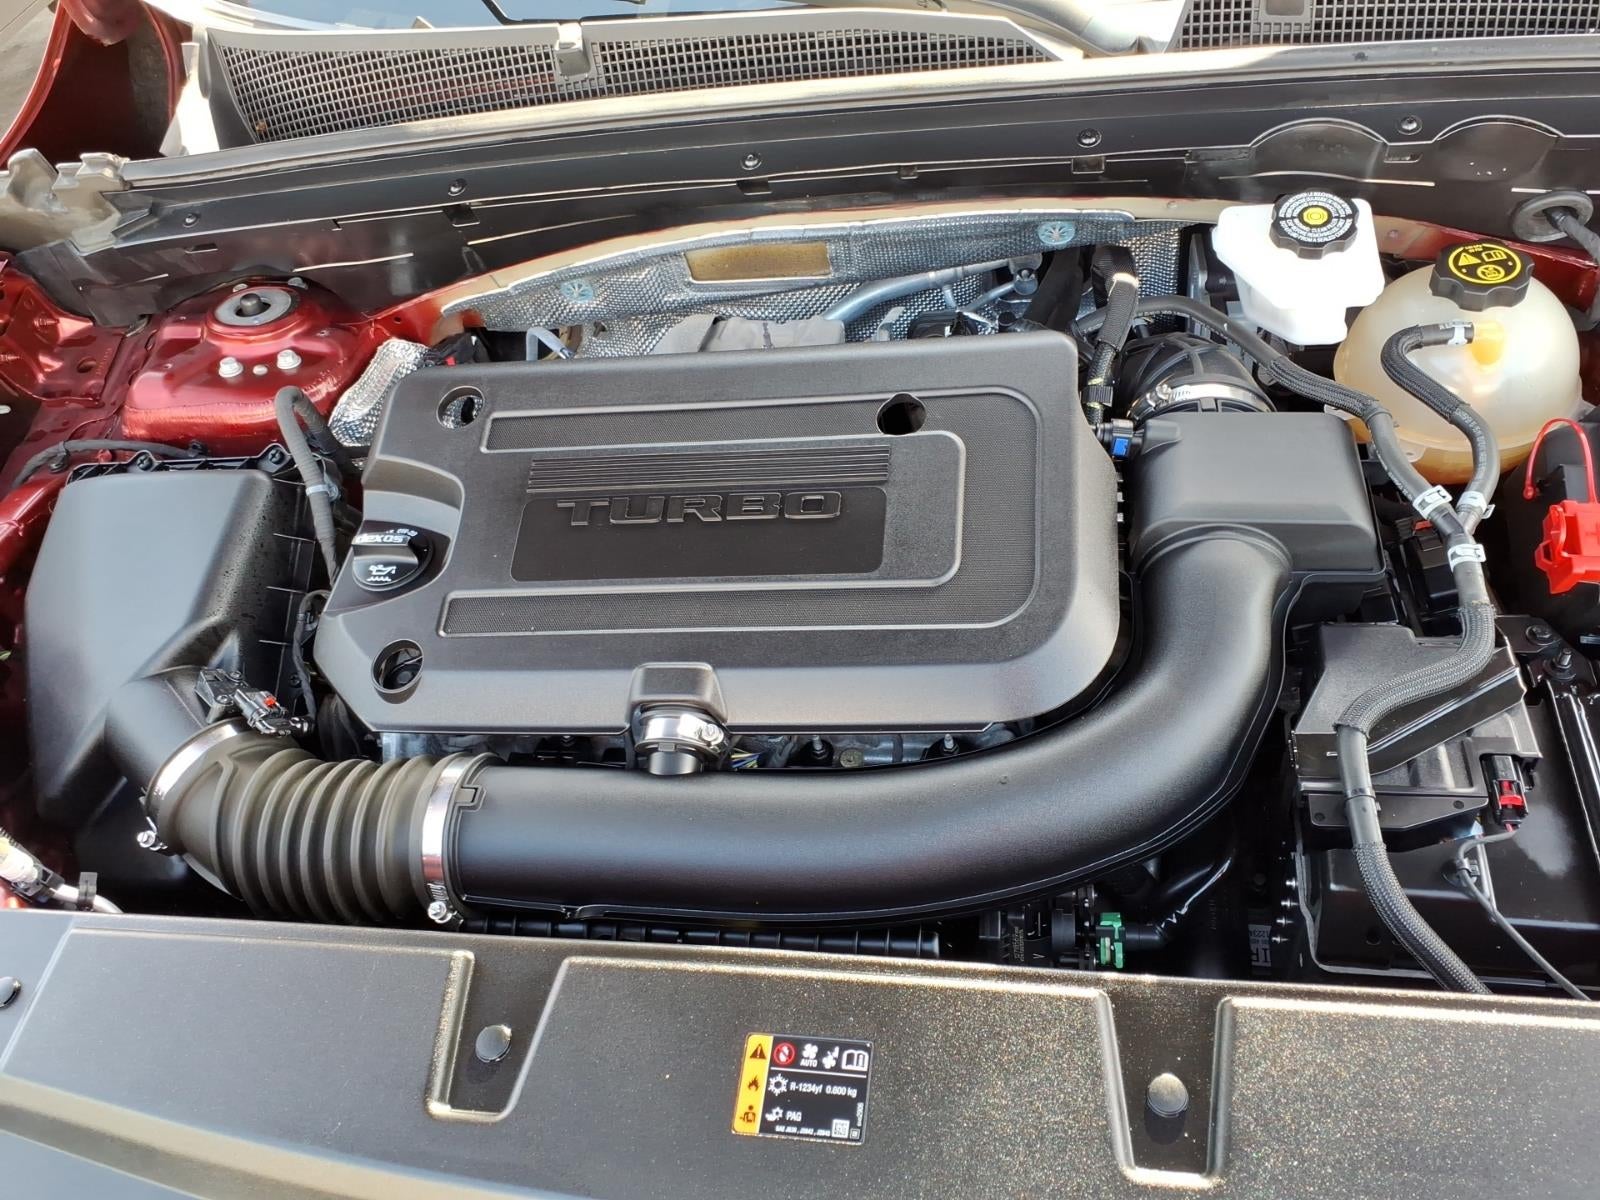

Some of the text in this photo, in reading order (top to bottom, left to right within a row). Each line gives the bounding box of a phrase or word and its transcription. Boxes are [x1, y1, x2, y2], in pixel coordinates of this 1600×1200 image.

[557, 491, 841, 526] TURBO
[799, 1058, 818, 1068] AUTO
[789, 1081, 823, 1095] R-1234yf
[847, 1087, 858, 1098] kg
[785, 1110, 802, 1122] PAG
